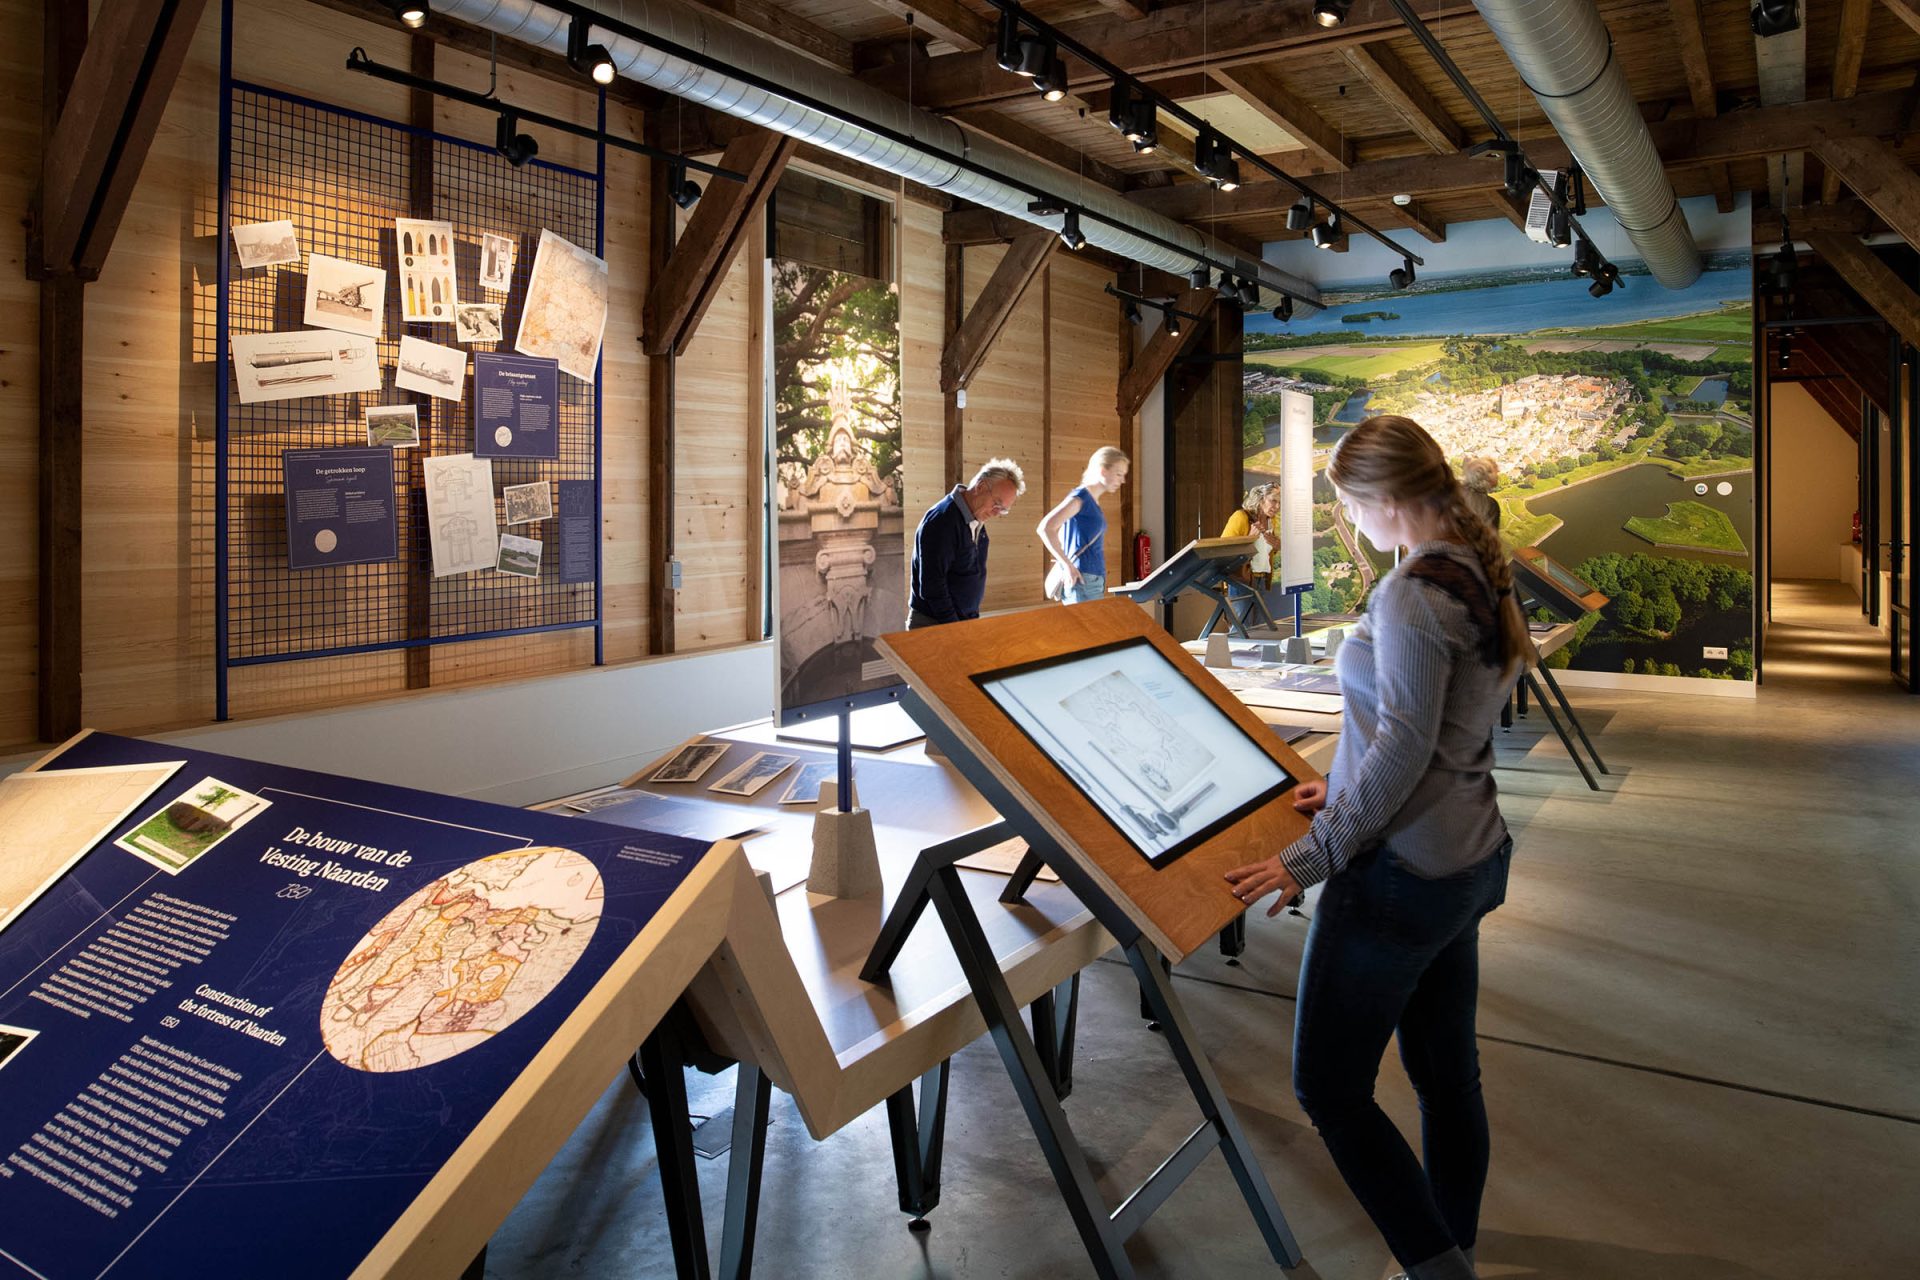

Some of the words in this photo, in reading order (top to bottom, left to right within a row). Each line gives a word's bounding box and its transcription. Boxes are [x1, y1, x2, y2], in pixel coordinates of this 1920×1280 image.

[283, 827, 310, 844] De
[306, 832, 358, 854] bouw
[354, 846, 388, 863] van
[386, 850, 412, 868] de
[260, 847, 320, 877] Vesting
[314, 861, 388, 892] Naarden
[196, 984, 258, 1014] Construction
[254, 1007, 274, 1018] of
[160, 1016, 180, 1028] 1350
[178, 999, 198, 1012] the
[194, 1004, 234, 1026] fortress
[230, 1020, 249, 1030] of
[240, 1022, 286, 1046] Naarden
